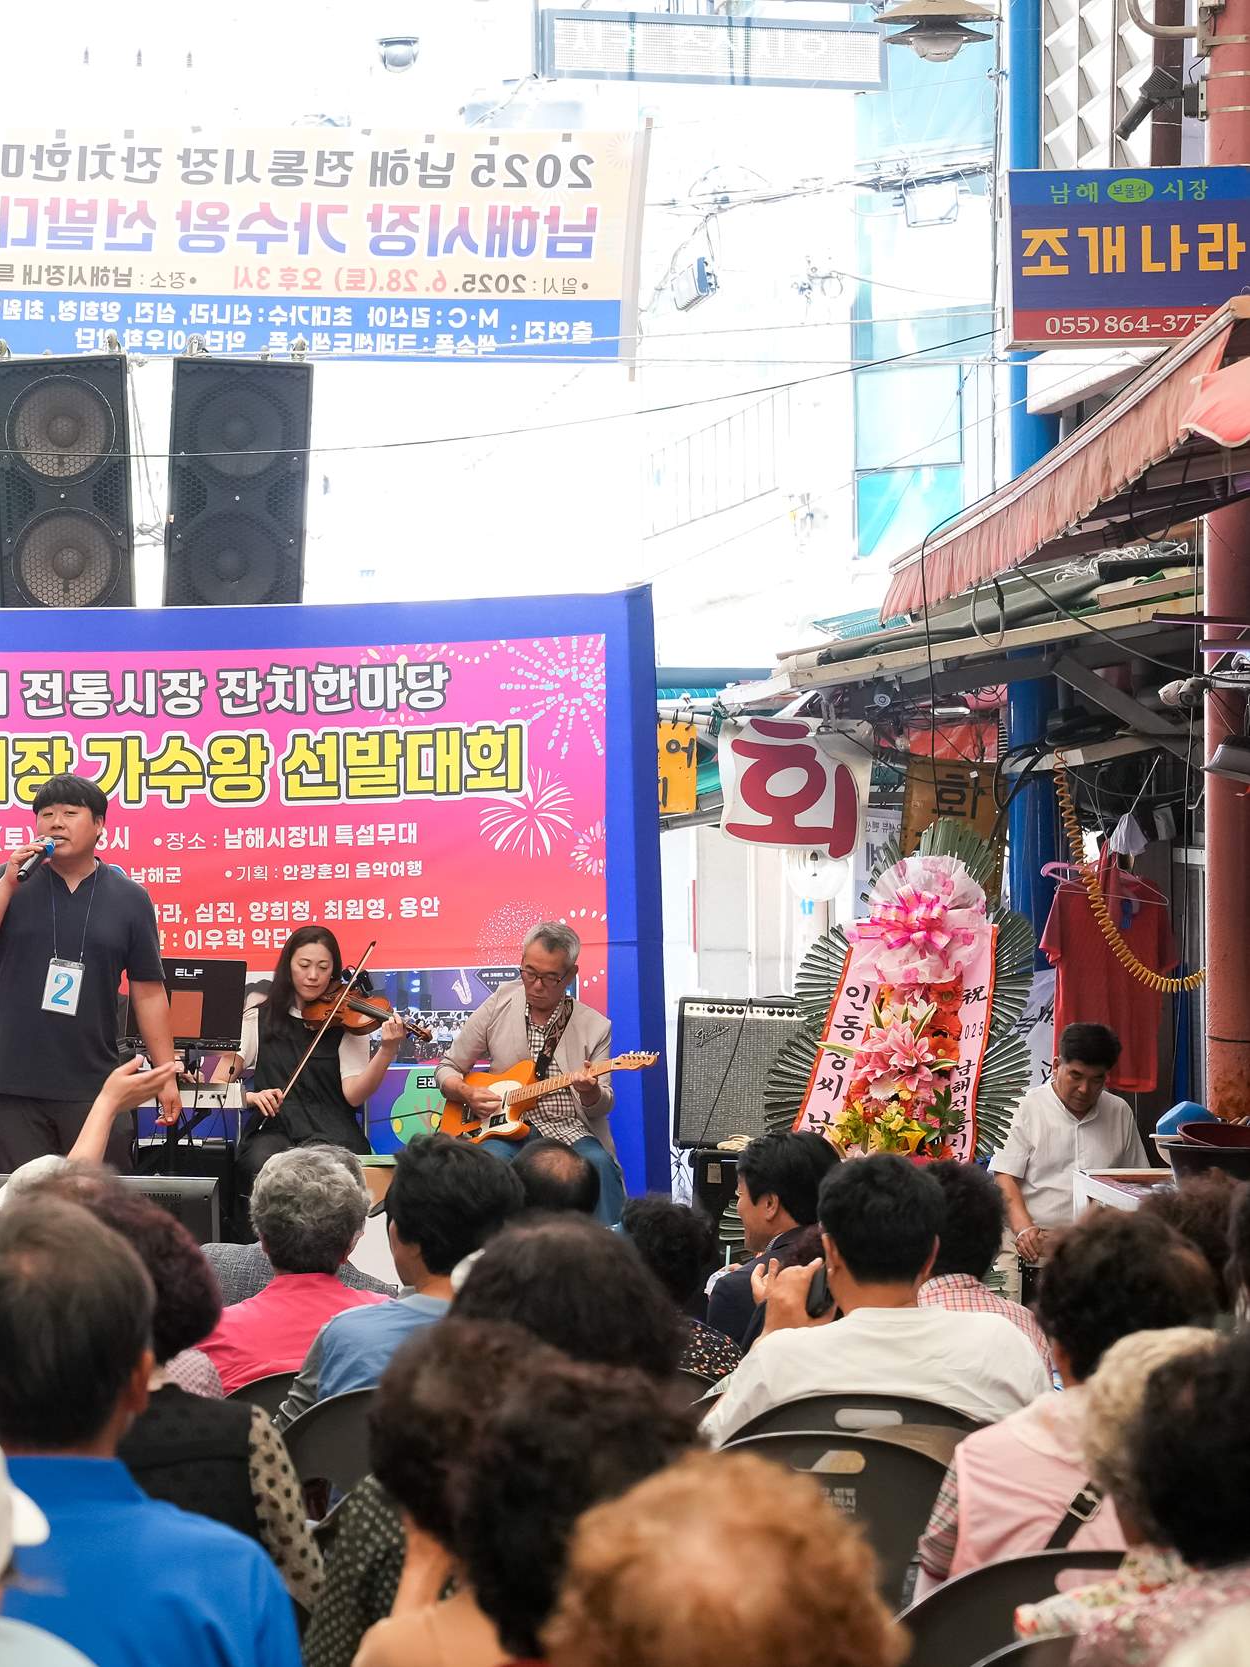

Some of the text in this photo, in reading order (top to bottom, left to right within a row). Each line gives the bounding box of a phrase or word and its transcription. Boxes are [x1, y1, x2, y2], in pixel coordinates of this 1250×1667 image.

[1050, 180, 1099, 205] 남해
[1161, 179, 1209, 201] 시장
[1021, 223, 1246, 276] 조개나라
[20, 669, 207, 720] 전통시장
[216, 661, 452, 718] 잔치한마당
[87, 734, 269, 803] 가수왕
[283, 725, 523, 800] 선발대회
[726, 719, 858, 858] 회
[224, 825, 328, 849] 남해시장내
[335, 822, 418, 846] 특설무대
[130, 867, 181, 883] 남해군
[282, 862, 350, 881] 안광훈의
[355, 860, 423, 879] 음악여행
[324, 898, 392, 921] 최원영,
[399, 896, 441, 918] 용안
[184, 928, 245, 950] 이우학
[251, 928, 292, 949] 악단
[174, 968, 204, 978] ELF
[51, 972, 75, 1007] 2
[964, 1021, 985, 1040] 025
